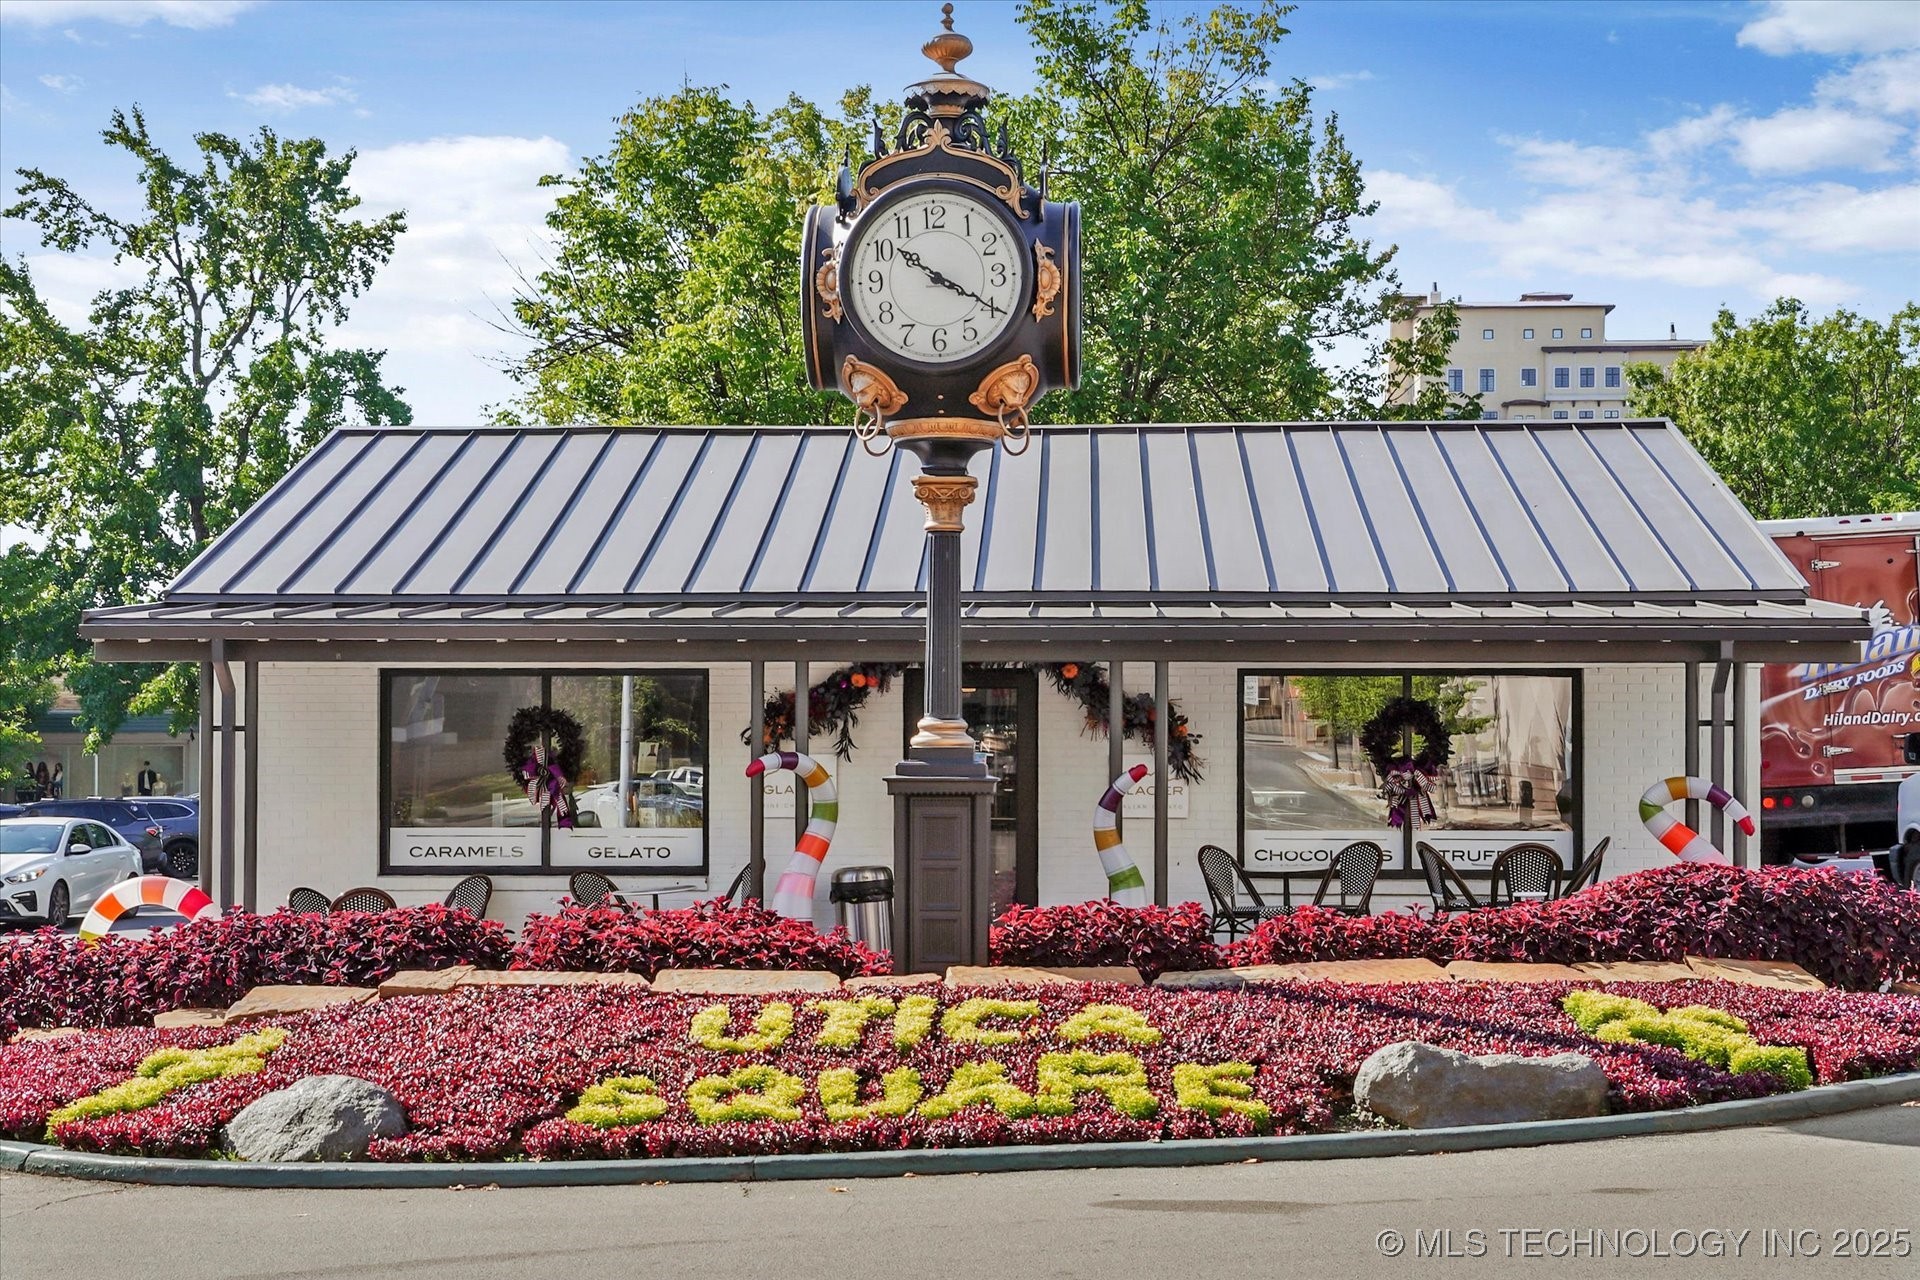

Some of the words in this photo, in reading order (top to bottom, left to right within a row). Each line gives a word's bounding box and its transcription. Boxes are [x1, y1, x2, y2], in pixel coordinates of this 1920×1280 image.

[894, 215, 912, 239] 11
[922, 205, 946, 230] 12
[963, 213, 973, 237] 1
[873, 238, 894, 262] 10
[981, 232, 997, 256] 2
[868, 270, 884, 294] 9
[990, 263, 1007, 287] 3
[878, 301, 894, 325] 8
[980, 296, 999, 319] 4
[899, 323, 916, 347] 7
[932, 328, 948, 352] 6
[962, 316, 978, 341] 5
[1855, 660, 1906, 686] FOODS
[409, 846, 525, 859] CARAMELS
[587, 846, 672, 859] GELATO
[690, 993, 1164, 1054] UTICA
[564, 1049, 1271, 1132] SQUARE
